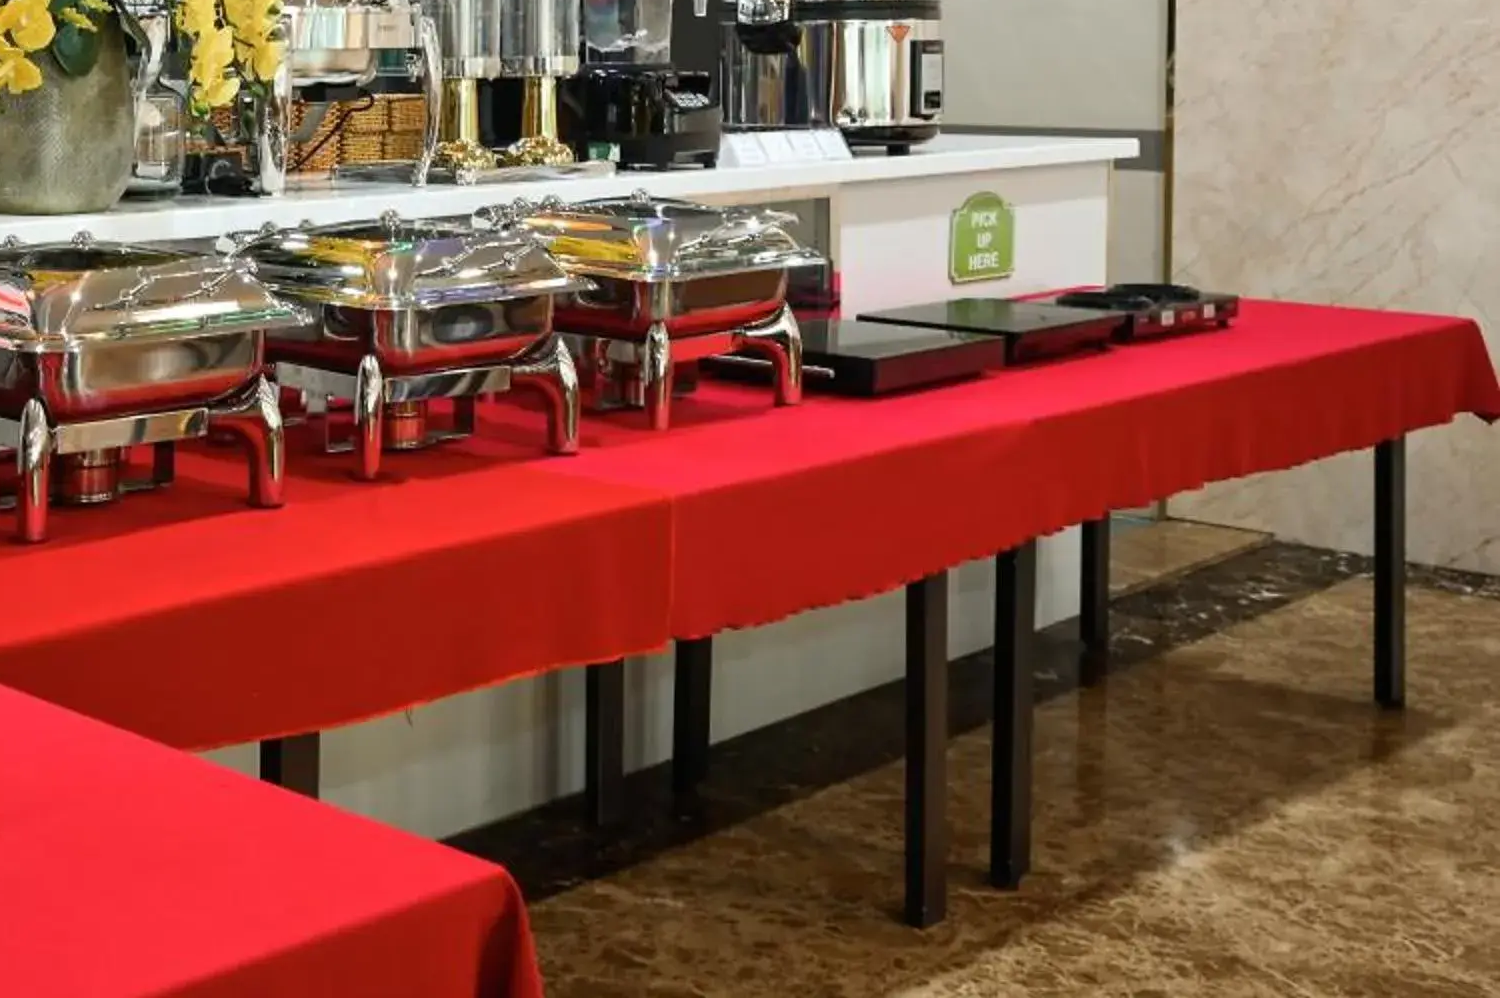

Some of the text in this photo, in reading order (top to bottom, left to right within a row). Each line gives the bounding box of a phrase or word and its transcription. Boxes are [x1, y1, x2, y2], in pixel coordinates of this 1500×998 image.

[970, 211, 998, 228] PICK
[977, 232, 993, 249] UP
[968, 252, 1000, 271] HERE
